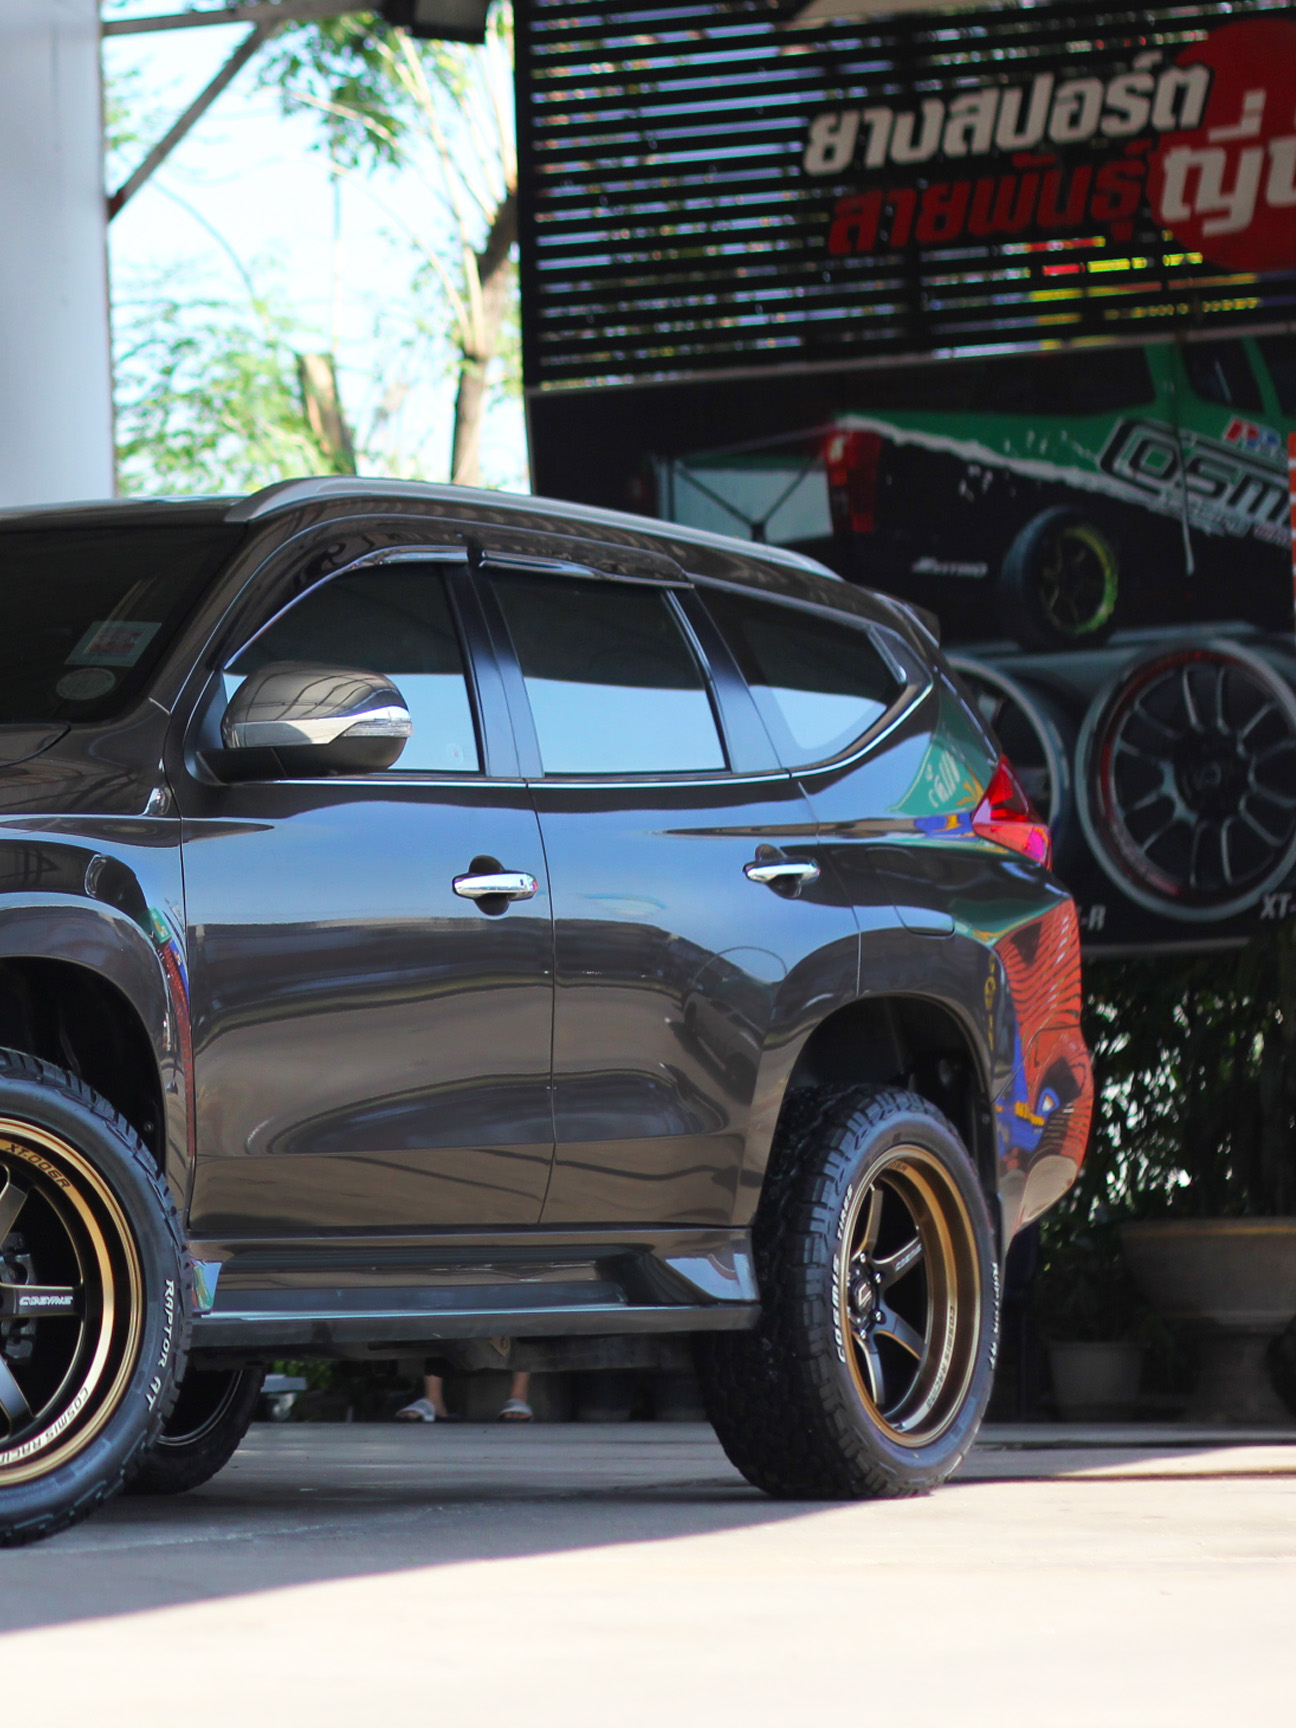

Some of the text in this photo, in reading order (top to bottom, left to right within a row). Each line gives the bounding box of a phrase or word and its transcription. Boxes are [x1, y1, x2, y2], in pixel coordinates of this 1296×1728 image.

[804, 50, 1211, 177] ยางสปอร์ต
[828, 140, 1152, 255] สายพันธุ์
[837, 1184, 853, 1240] TIRES
[157, 1279, 175, 1368] RAPTOR
[46, 1387, 89, 1440] COSMIS
